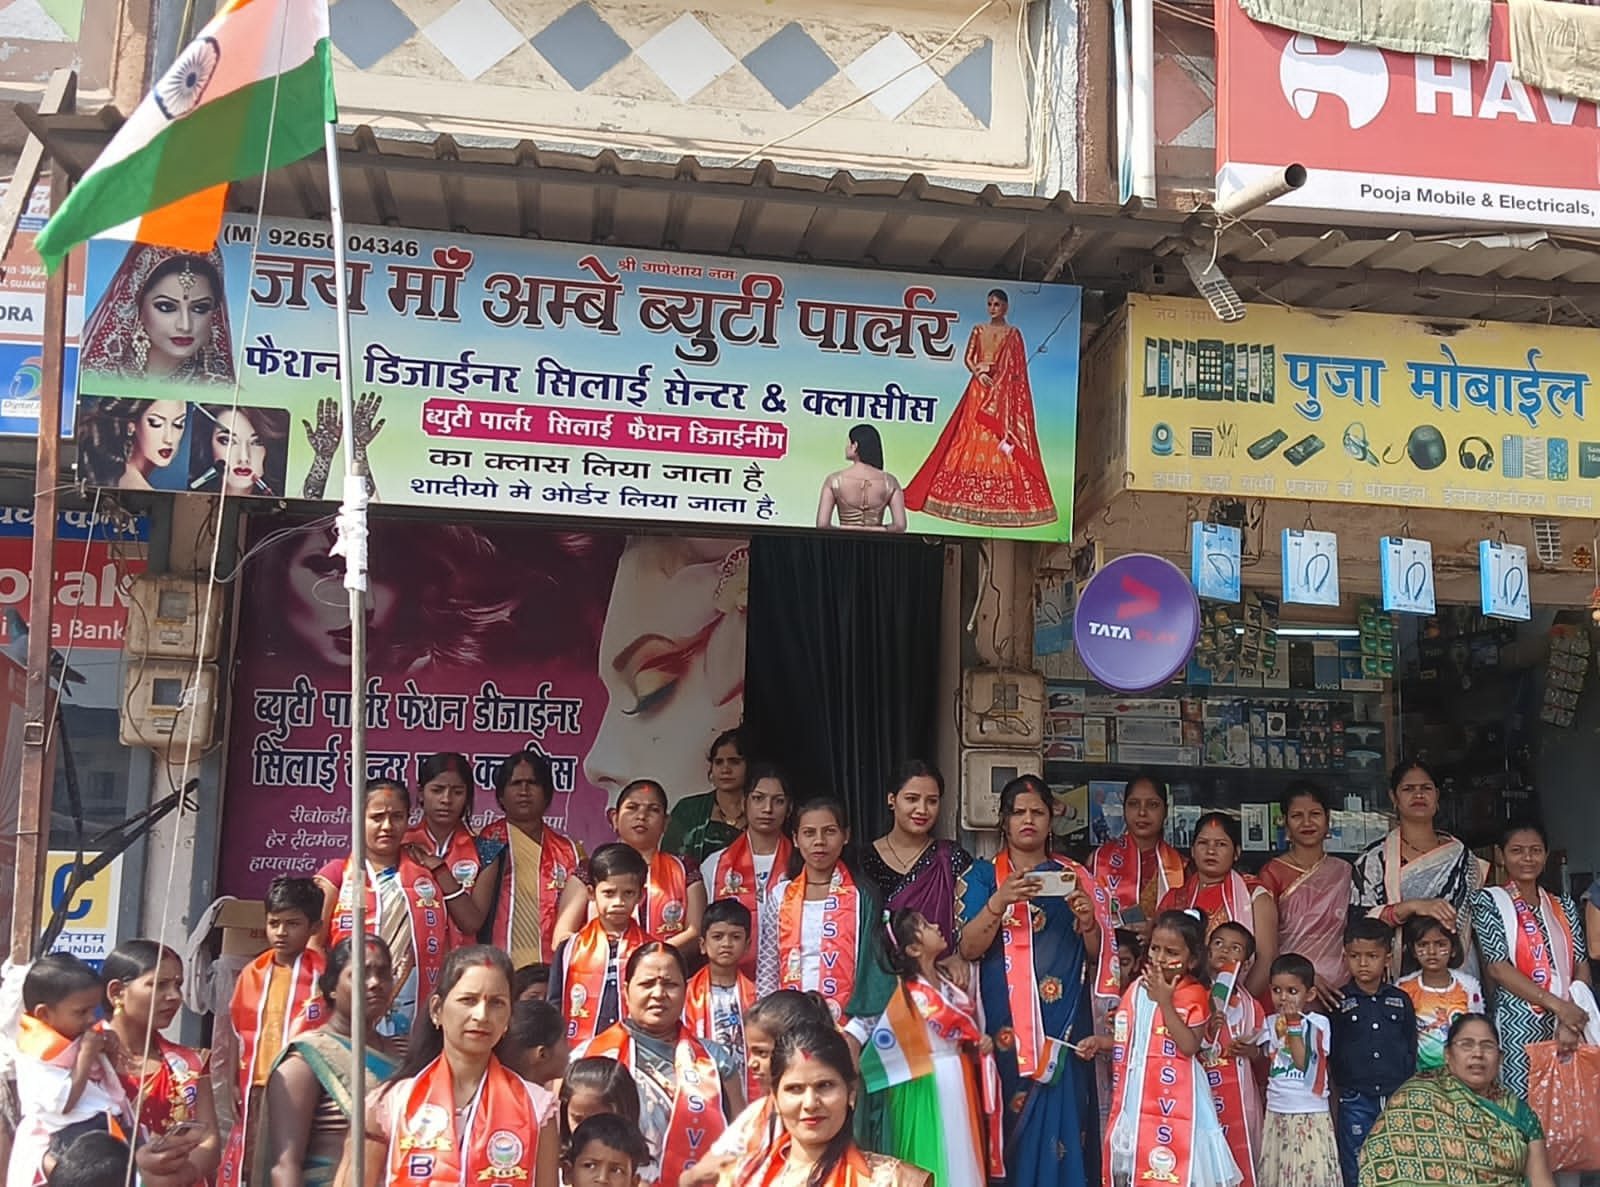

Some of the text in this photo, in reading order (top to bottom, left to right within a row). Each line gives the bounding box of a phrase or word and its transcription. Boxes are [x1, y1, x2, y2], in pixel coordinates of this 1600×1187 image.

[1360, 184, 1595, 216] Pooja Mobile & Electricals,
[349, 235, 418, 257] 04346
[617, 256, 637, 272] श्री
[251, 253, 372, 313] जय
[482, 255, 624, 335] अम्बे
[638, 272, 784, 365] ब्युटी
[796, 285, 959, 360] पार्लर
[362, 343, 521, 394] डिजाईनर
[535, 357, 653, 407] सिलाई
[663, 368, 748, 410] सेन्टर
[761, 383, 787, 413] &
[802, 383, 938, 422] क्लासीस
[1282, 343, 1591, 427] पुजा मोबाईल
[425, 404, 472, 433] ब्युटी
[480, 408, 533, 432] पार्लर
[548, 411, 614, 440] सिलाई
[627, 416, 681, 443] फैशन
[428, 449, 765, 492] का क्लास लिया जाता है
[411, 474, 499, 498] शादीयो
[509, 479, 532, 501] मे
[542, 482, 610, 505] ओर्डर
[620, 486, 678, 509] लिया
[688, 495, 747, 513] जाता
[1089, 622, 1131, 640] TATA
[396, 679, 469, 731] फेशन
[473, 680, 582, 739] डीजाईनर
[252, 734, 341, 793] सिलाई
[69, 945, 105, 953] INDIA
